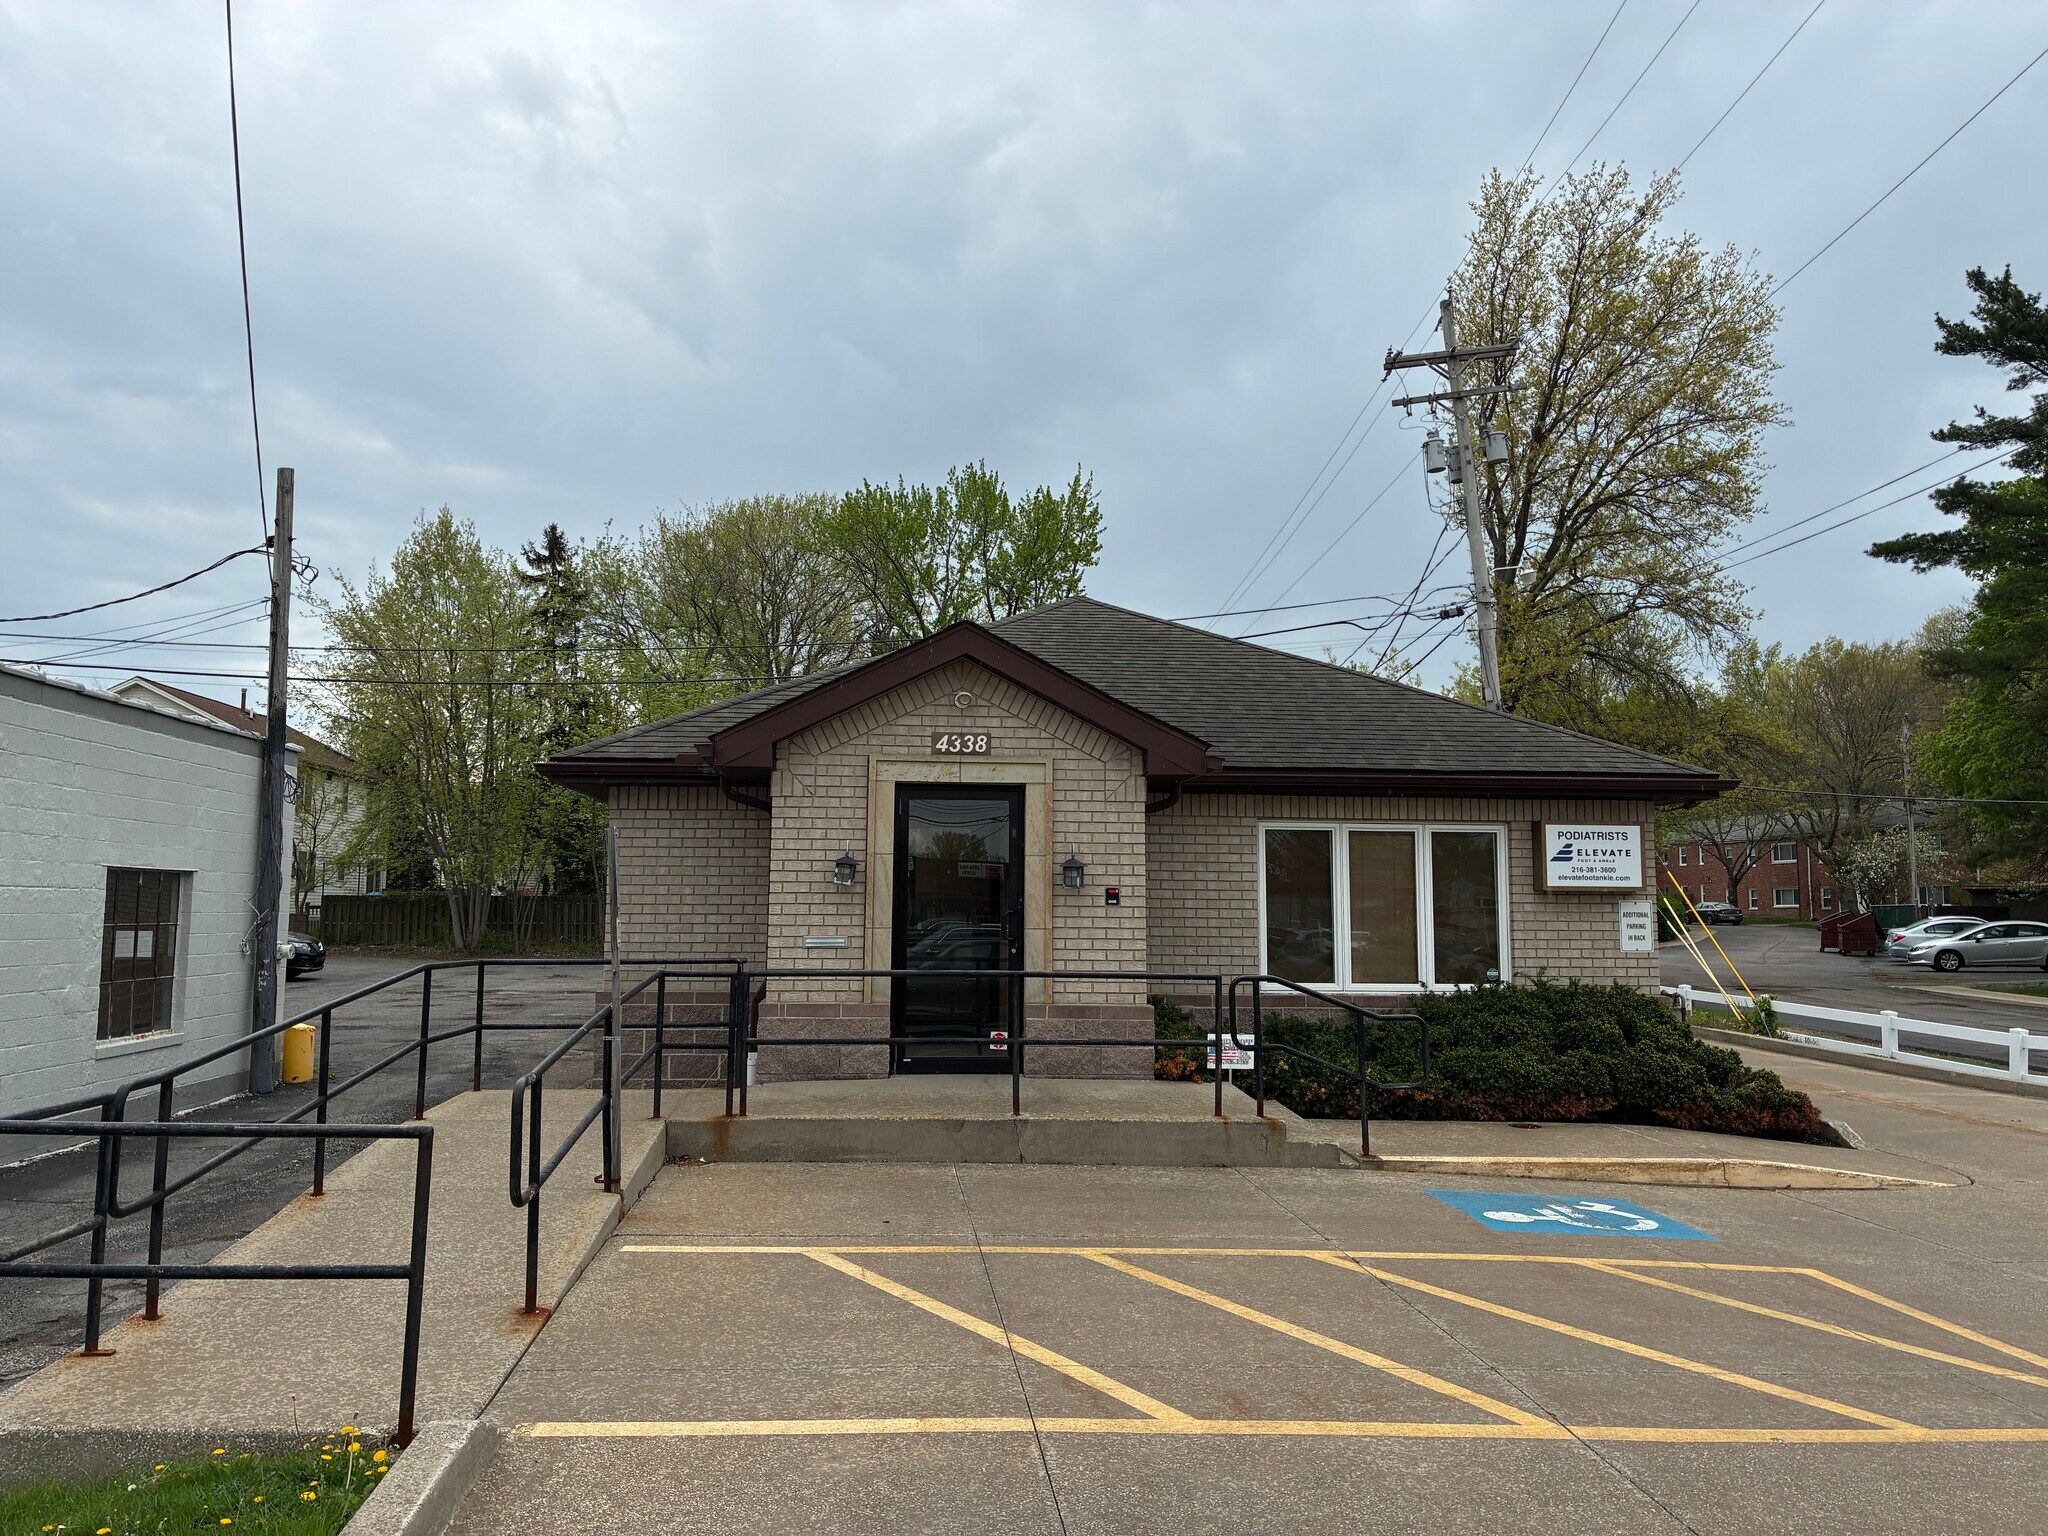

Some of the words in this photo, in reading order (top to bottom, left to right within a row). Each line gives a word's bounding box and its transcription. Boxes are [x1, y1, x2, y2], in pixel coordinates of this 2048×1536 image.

[935, 734, 988, 753] 4338
[1557, 831, 1629, 841] PODIATRISTS
[1576, 848, 1632, 857] ELEVATE
[1571, 866, 1617, 874] 216-381-3600
[1557, 874, 1631, 882] elevatefootankle.com
[1622, 911, 1650, 919] ADDITIONAL
[1634, 934, 1647, 942] BACK
